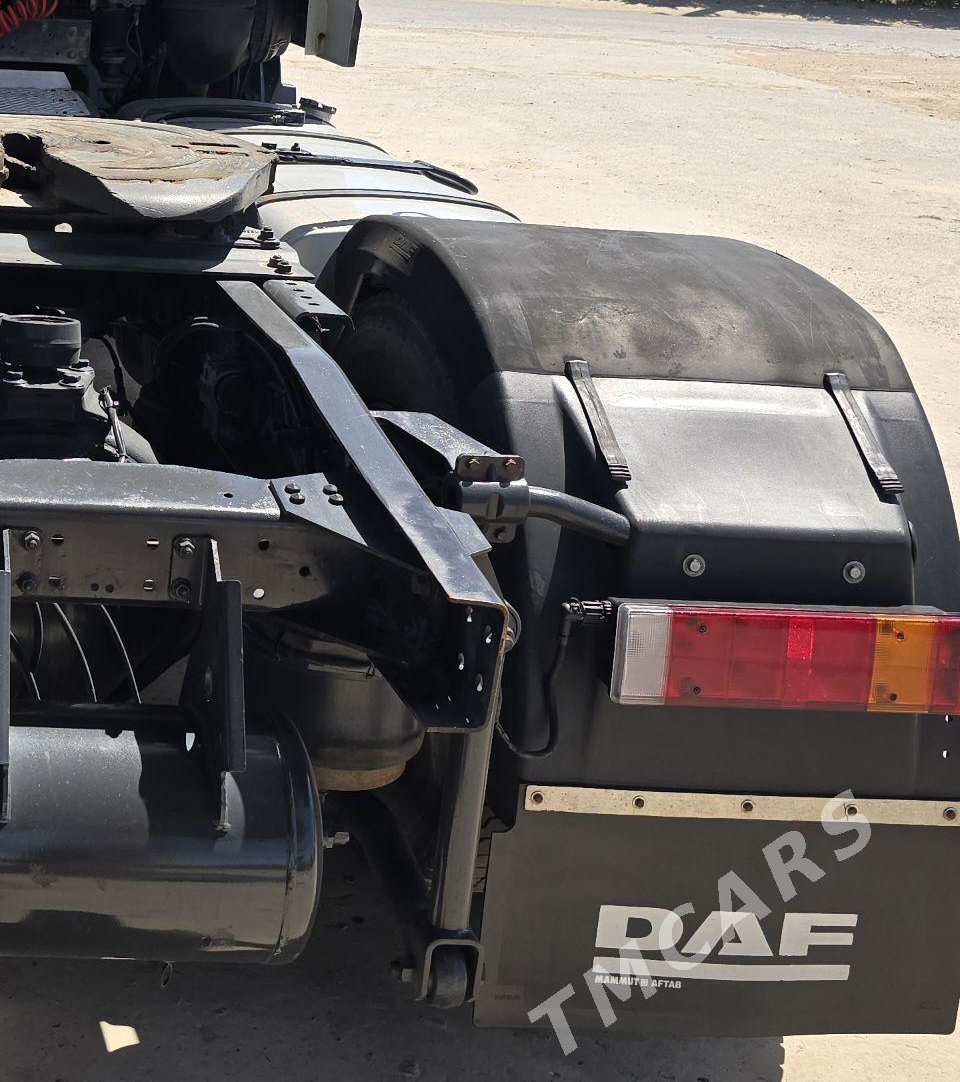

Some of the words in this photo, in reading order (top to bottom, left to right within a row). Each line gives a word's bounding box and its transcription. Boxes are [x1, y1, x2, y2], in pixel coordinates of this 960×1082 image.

[594, 904, 859, 957] DAF
[594, 974, 640, 987] MAMMUT
[650, 978, 682, 989] AFTAB
